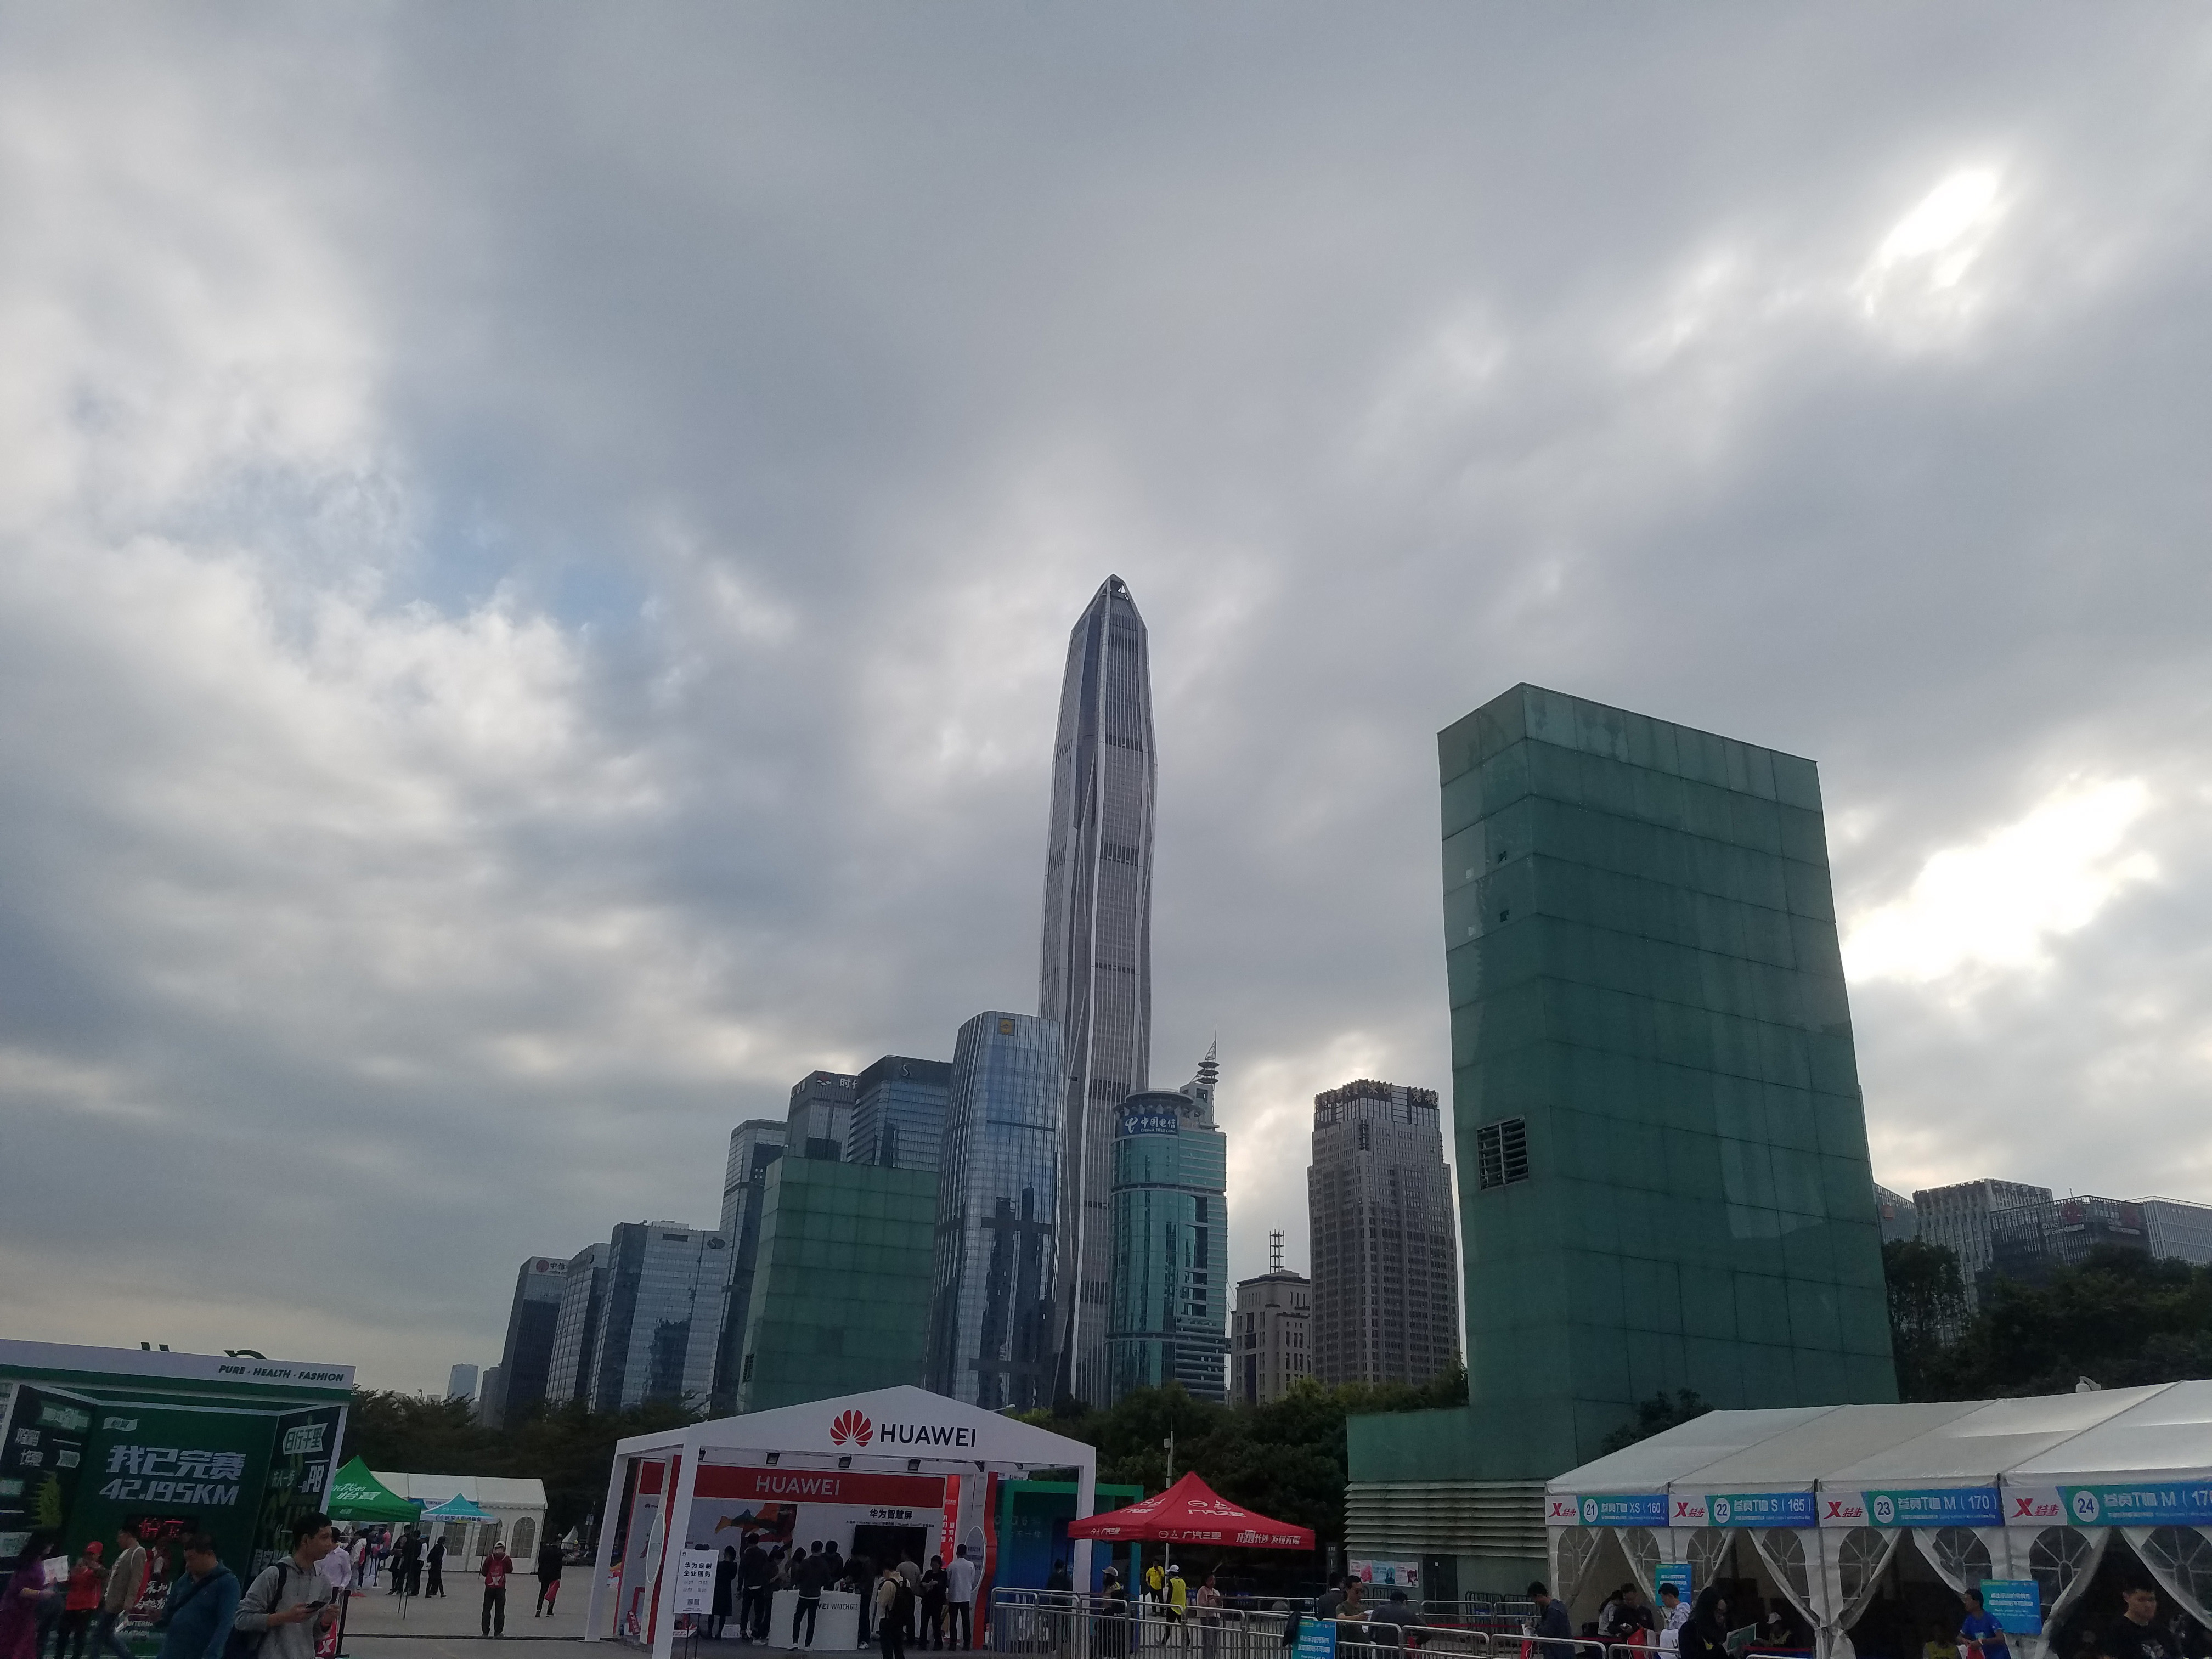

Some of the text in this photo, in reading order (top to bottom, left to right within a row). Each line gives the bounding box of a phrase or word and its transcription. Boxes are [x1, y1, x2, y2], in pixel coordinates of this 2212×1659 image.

[1141, 1116, 1176, 1128] 中国电信
[218, 1365, 344, 1381] PURE HEALTH FASHION
[880, 1423, 976, 1447] HUAWEI
[106, 1444, 246, 1480] 我已完赛
[99, 1478, 240, 1505] 42.195KM
[755, 1475, 840, 1496] HUAWEI
[1944, 1496, 1956, 1510] M
[2160, 1490, 2176, 1507] M
[1586, 1504, 1594, 1516] 21
[1629, 1502, 1640, 1513] XS
[1717, 1503, 1728, 1516] 22
[1771, 1499, 1778, 1512] S
[1842, 1507, 1863, 1517] 特步
[1877, 1502, 1891, 1516] 23
[2033, 1504, 2059, 1516] 特步
[2077, 1498, 2095, 1513] 24
[870, 1508, 913, 1520] 华为智慧屏
[1188, 1509, 1246, 1517] 广汽三菱
[1687, 1508, 1705, 1517] 特步
[1182, 1531, 1221, 1540] 广汽三菱
